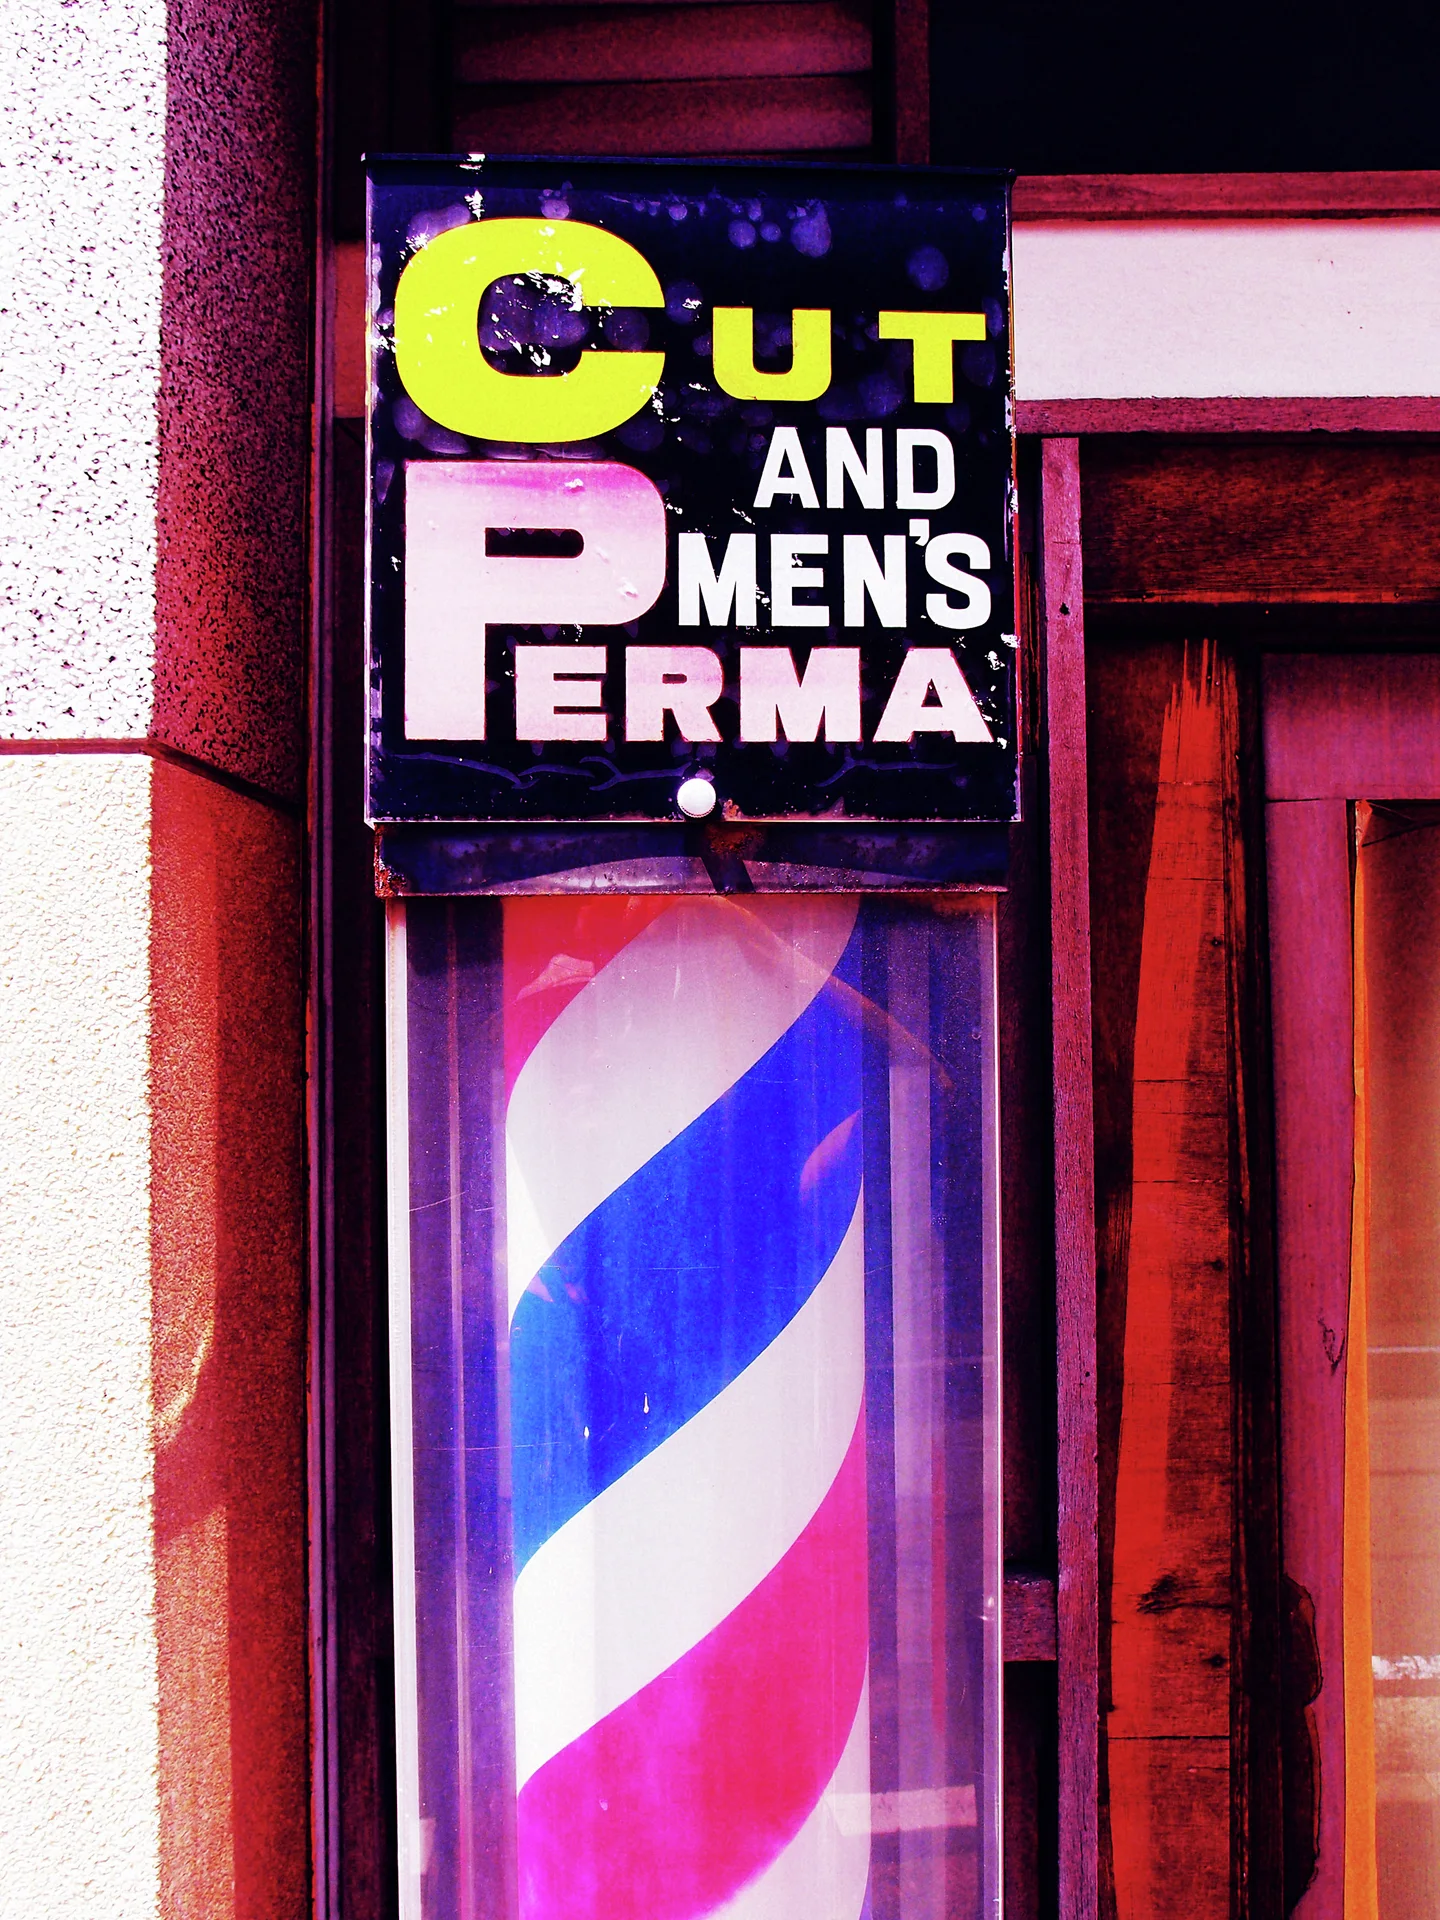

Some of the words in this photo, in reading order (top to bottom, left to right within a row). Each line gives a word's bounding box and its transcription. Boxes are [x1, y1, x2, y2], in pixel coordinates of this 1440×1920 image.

[394, 217, 987, 443] CUT
[753, 427, 956, 510] AND
[404, 459, 994, 743] PERMA
[677, 518, 992, 630] MEN'S
